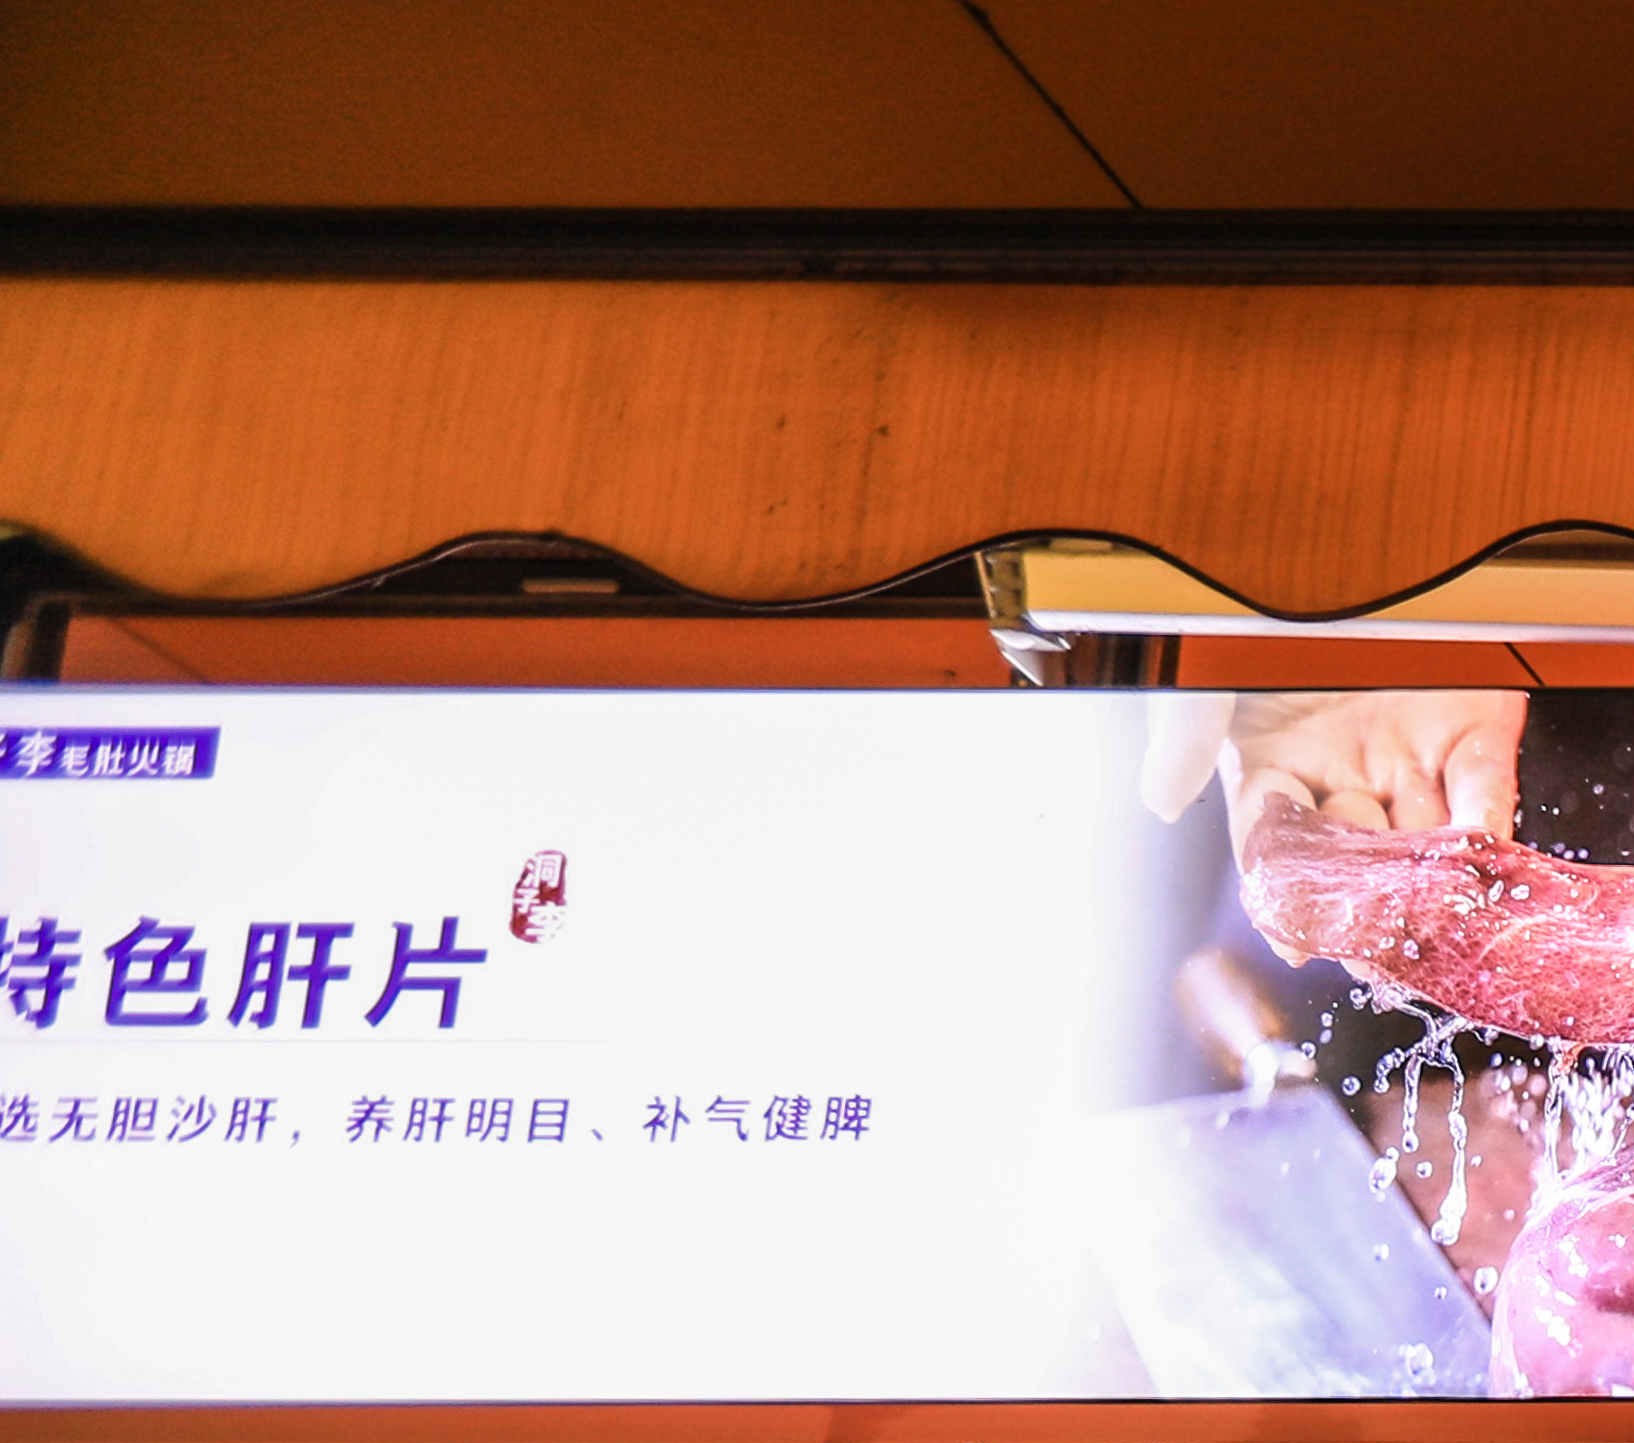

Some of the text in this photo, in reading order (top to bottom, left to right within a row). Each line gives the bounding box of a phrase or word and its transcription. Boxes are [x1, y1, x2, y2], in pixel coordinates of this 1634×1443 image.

[0, 730, 197, 777] 李毛肚火锅
[0, 915, 489, 1031] 特色肝片
